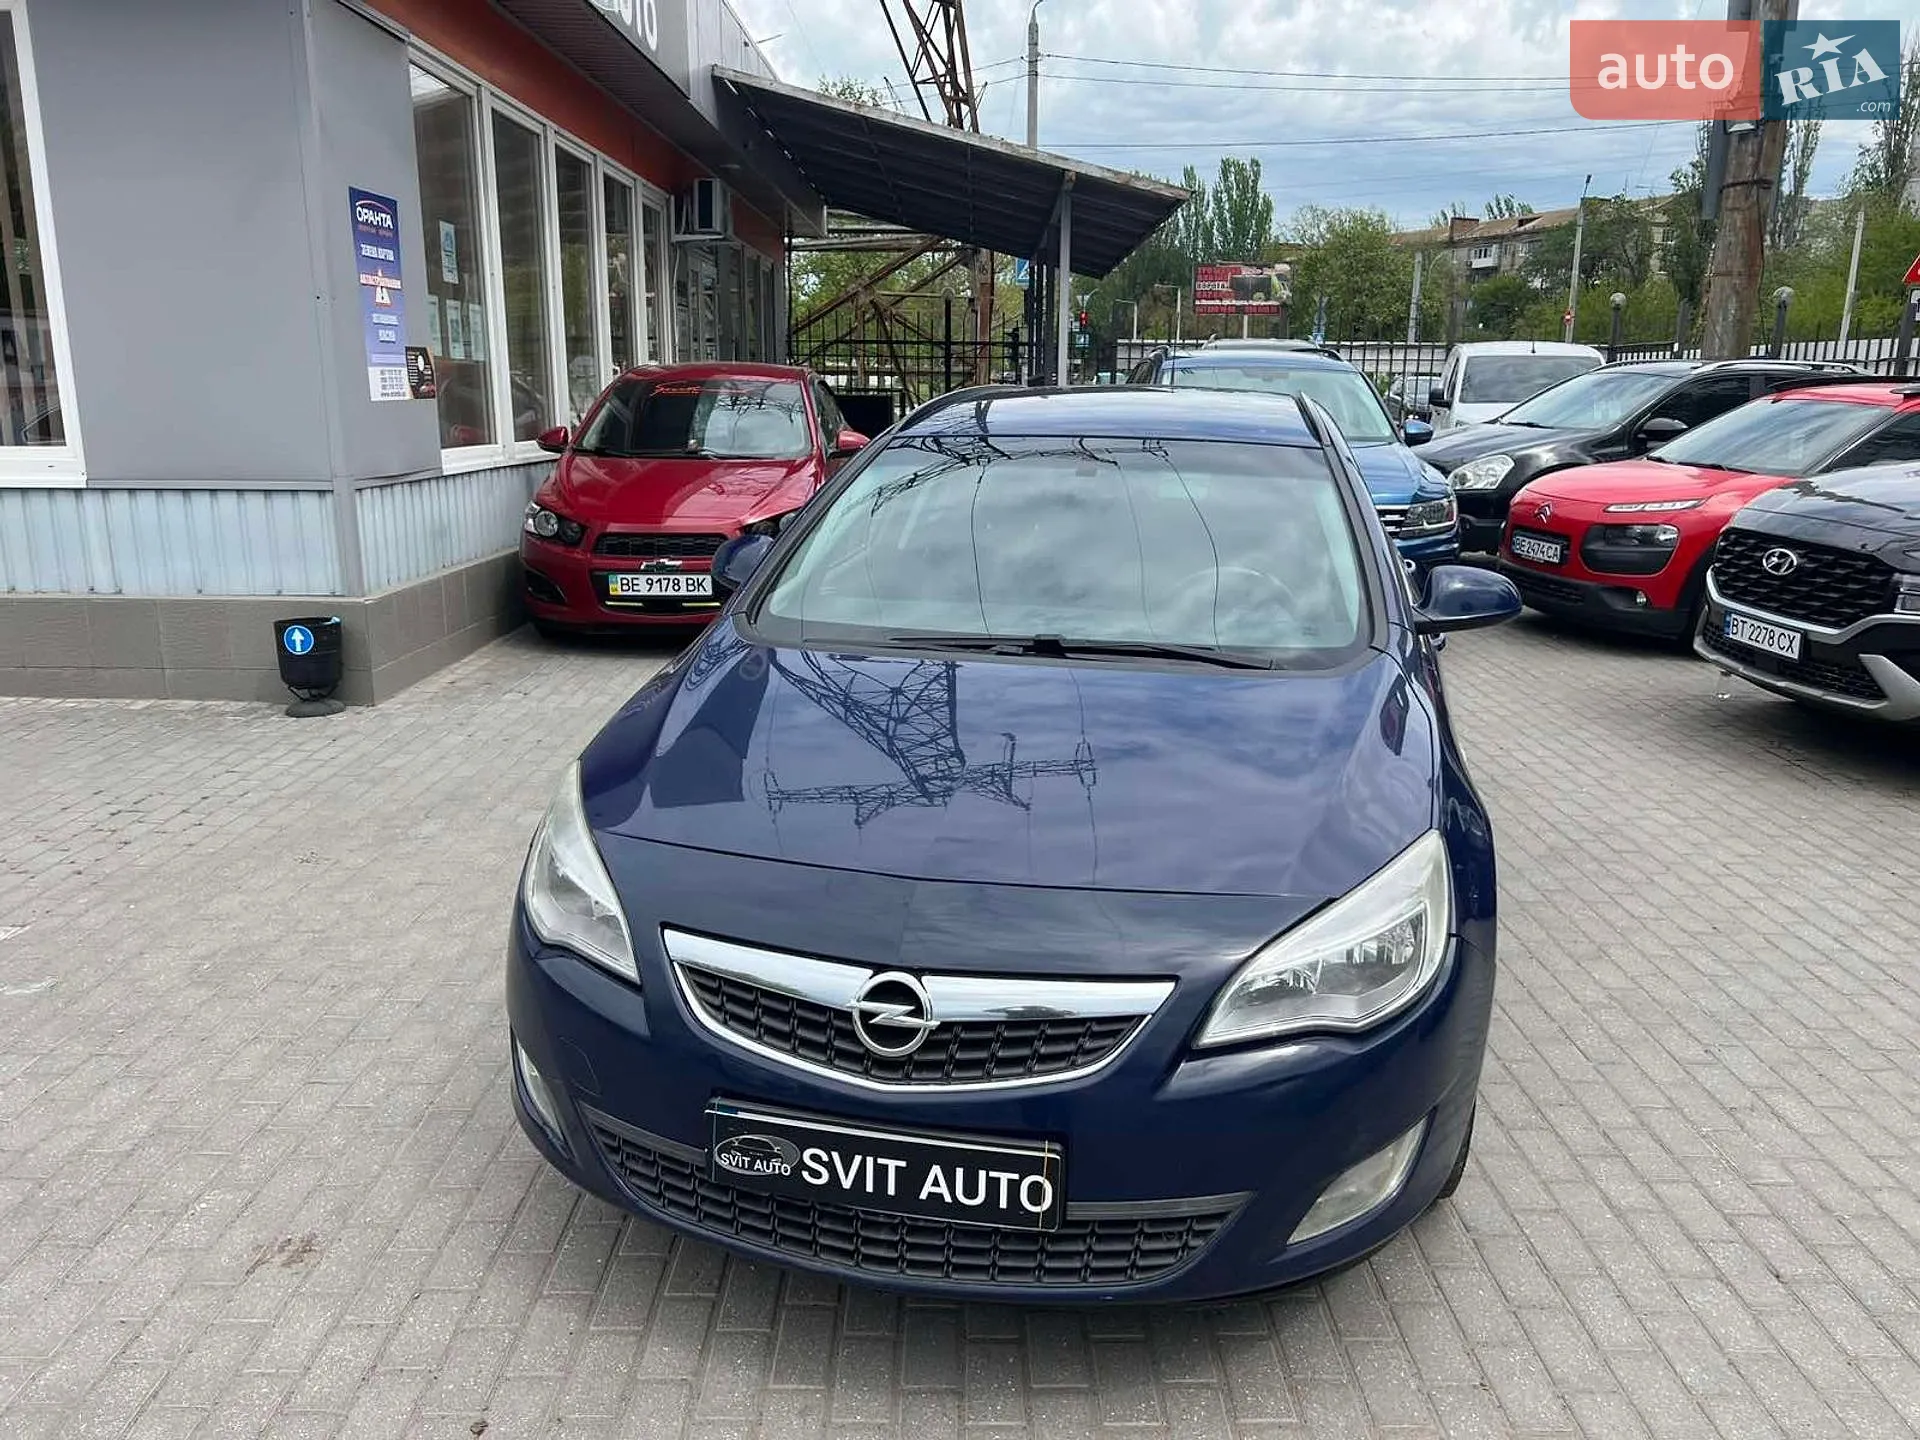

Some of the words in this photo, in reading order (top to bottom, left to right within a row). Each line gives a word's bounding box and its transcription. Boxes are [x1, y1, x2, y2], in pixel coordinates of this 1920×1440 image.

[356, 206, 393, 229] ОРАНТА
[620, 577, 641, 593] BE
[645, 577, 681, 593] 9178
[685, 577, 707, 593] BK
[1731, 617, 1748, 637] BT
[1748, 623, 1775, 647] 2278
[1777, 632, 1796, 654] CX
[720, 1152, 751, 1169] SVIT
[753, 1156, 791, 1177] AUTO
[801, 1148, 907, 1196] SVIT
[919, 1164, 1053, 1213] AUTO
